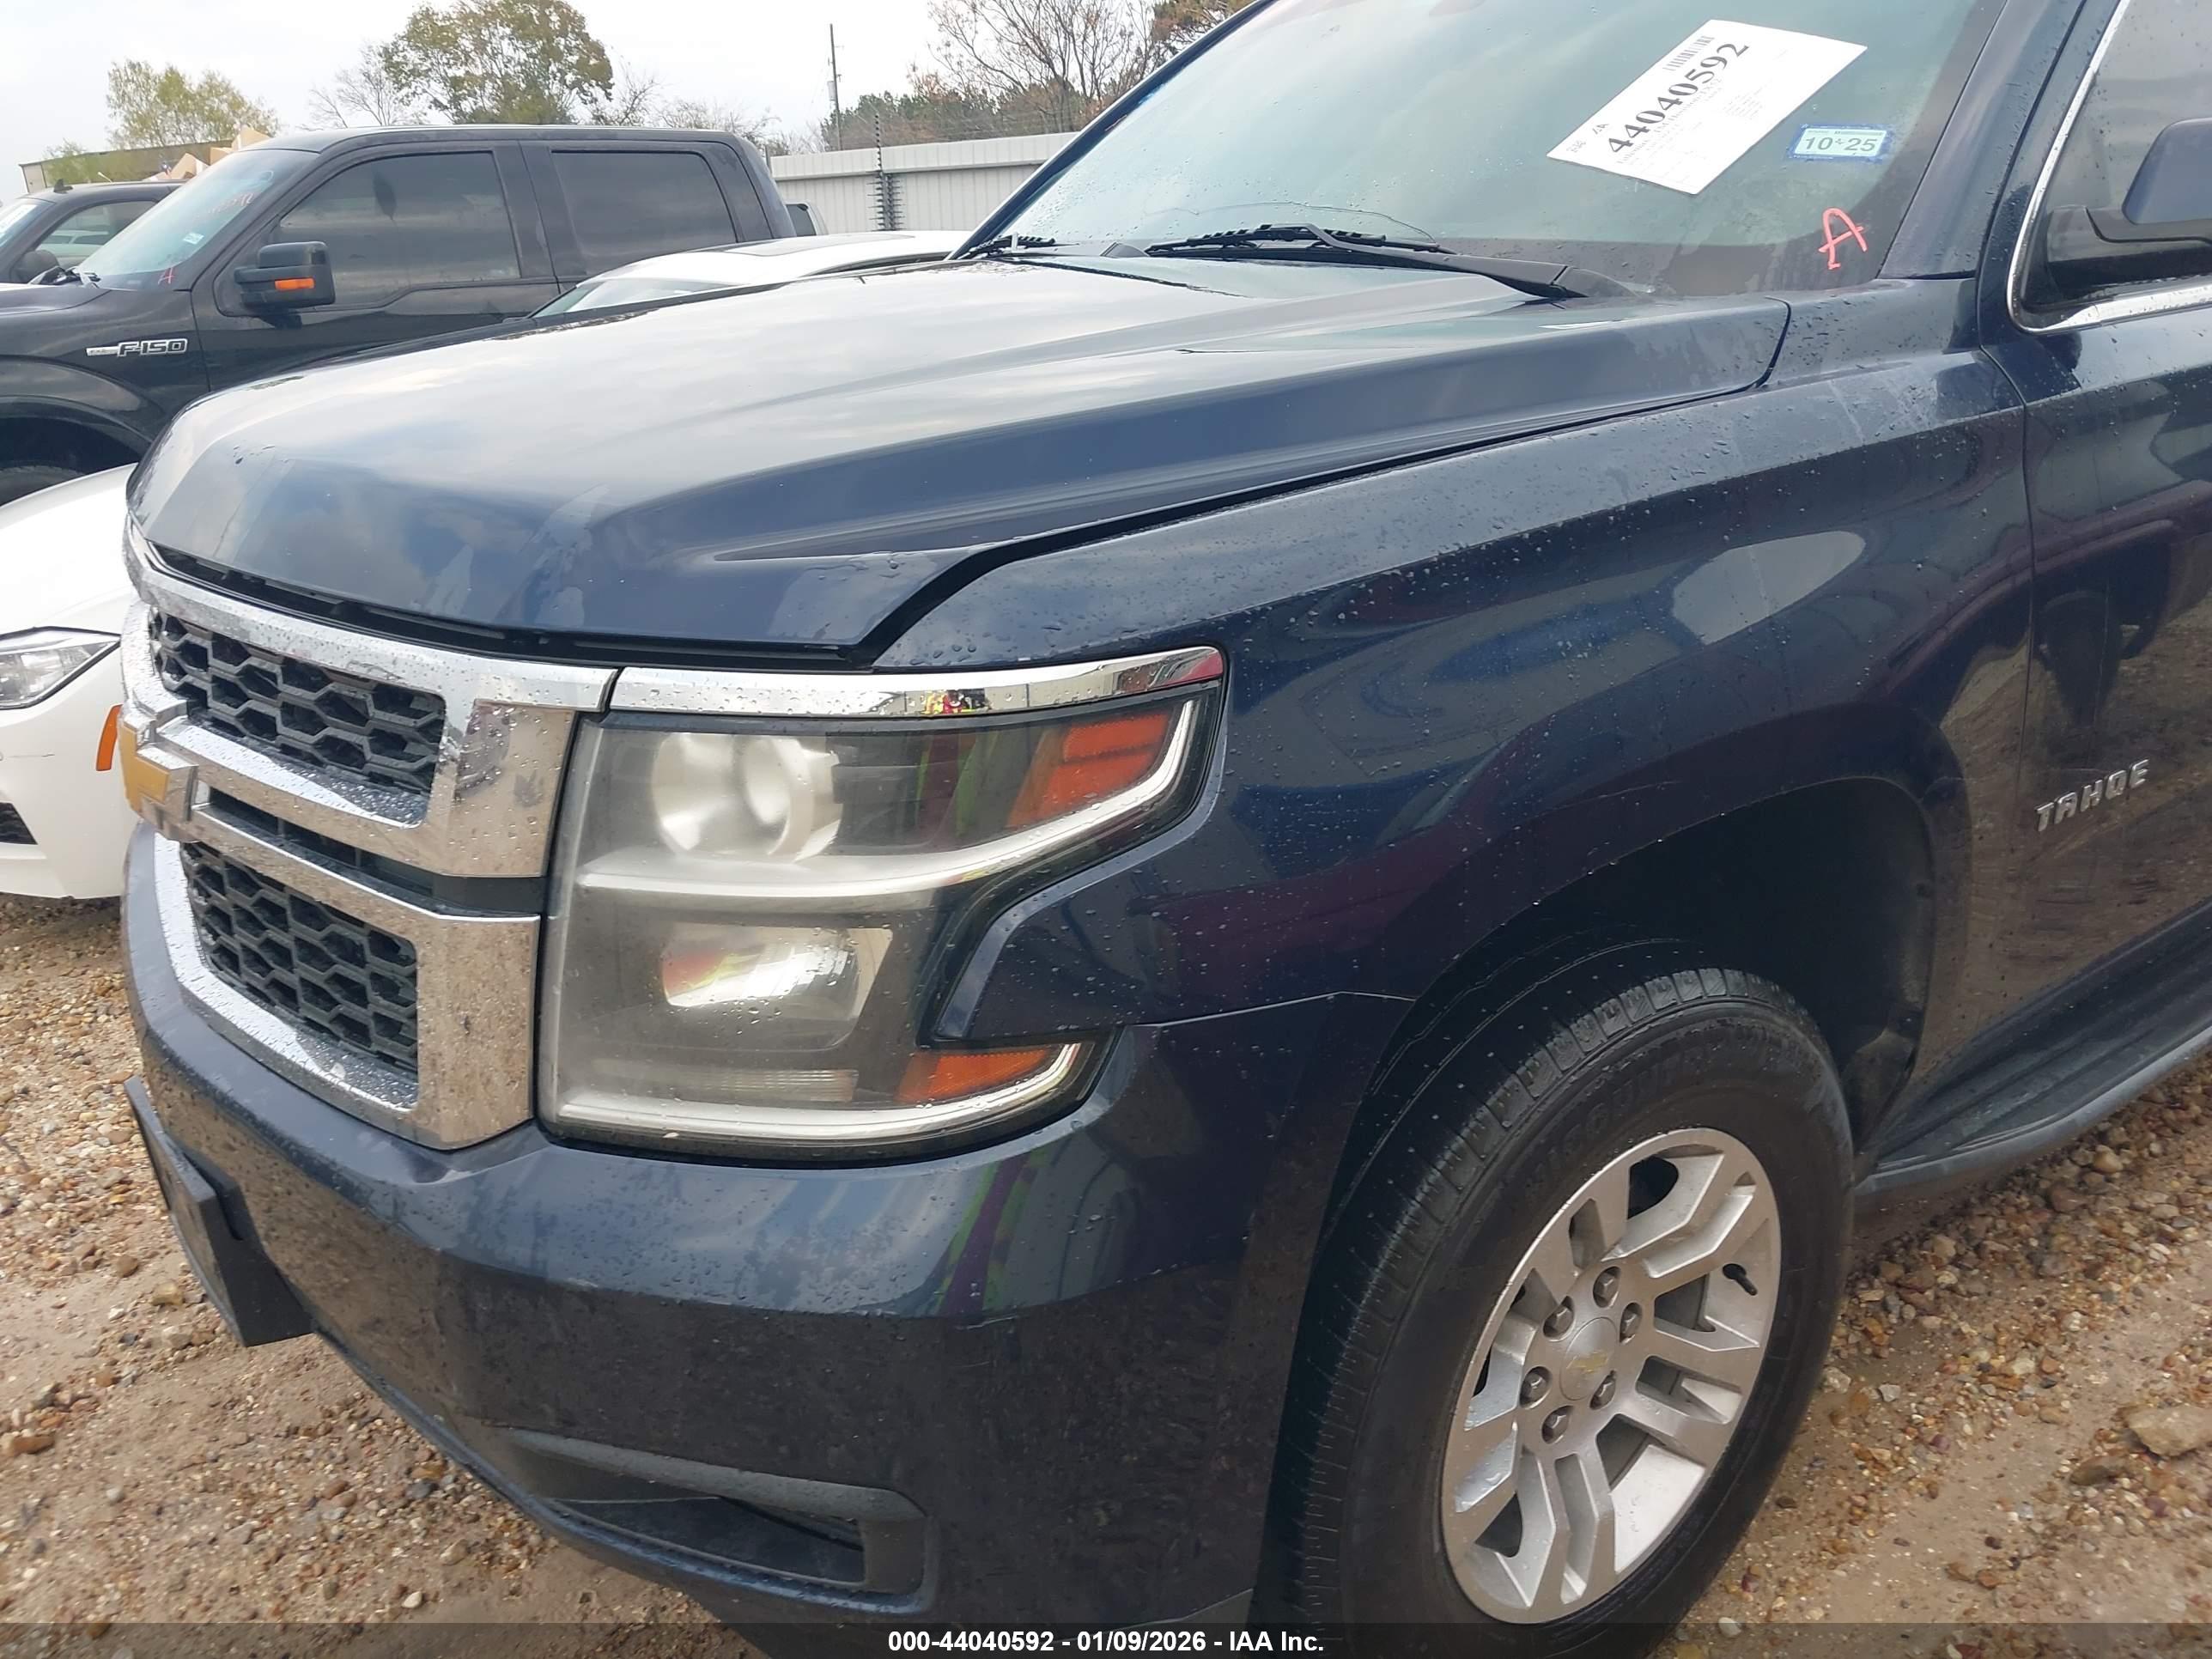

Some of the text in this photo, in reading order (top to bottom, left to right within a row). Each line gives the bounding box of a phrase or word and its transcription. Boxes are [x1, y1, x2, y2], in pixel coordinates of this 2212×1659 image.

[1608, 43, 1750, 153] 44040592
[1805, 136, 1878, 152] 10 25
[1818, 207, 1868, 270] A
[117, 337, 188, 357] F-150
[2034, 758, 2149, 832] TAHOE
